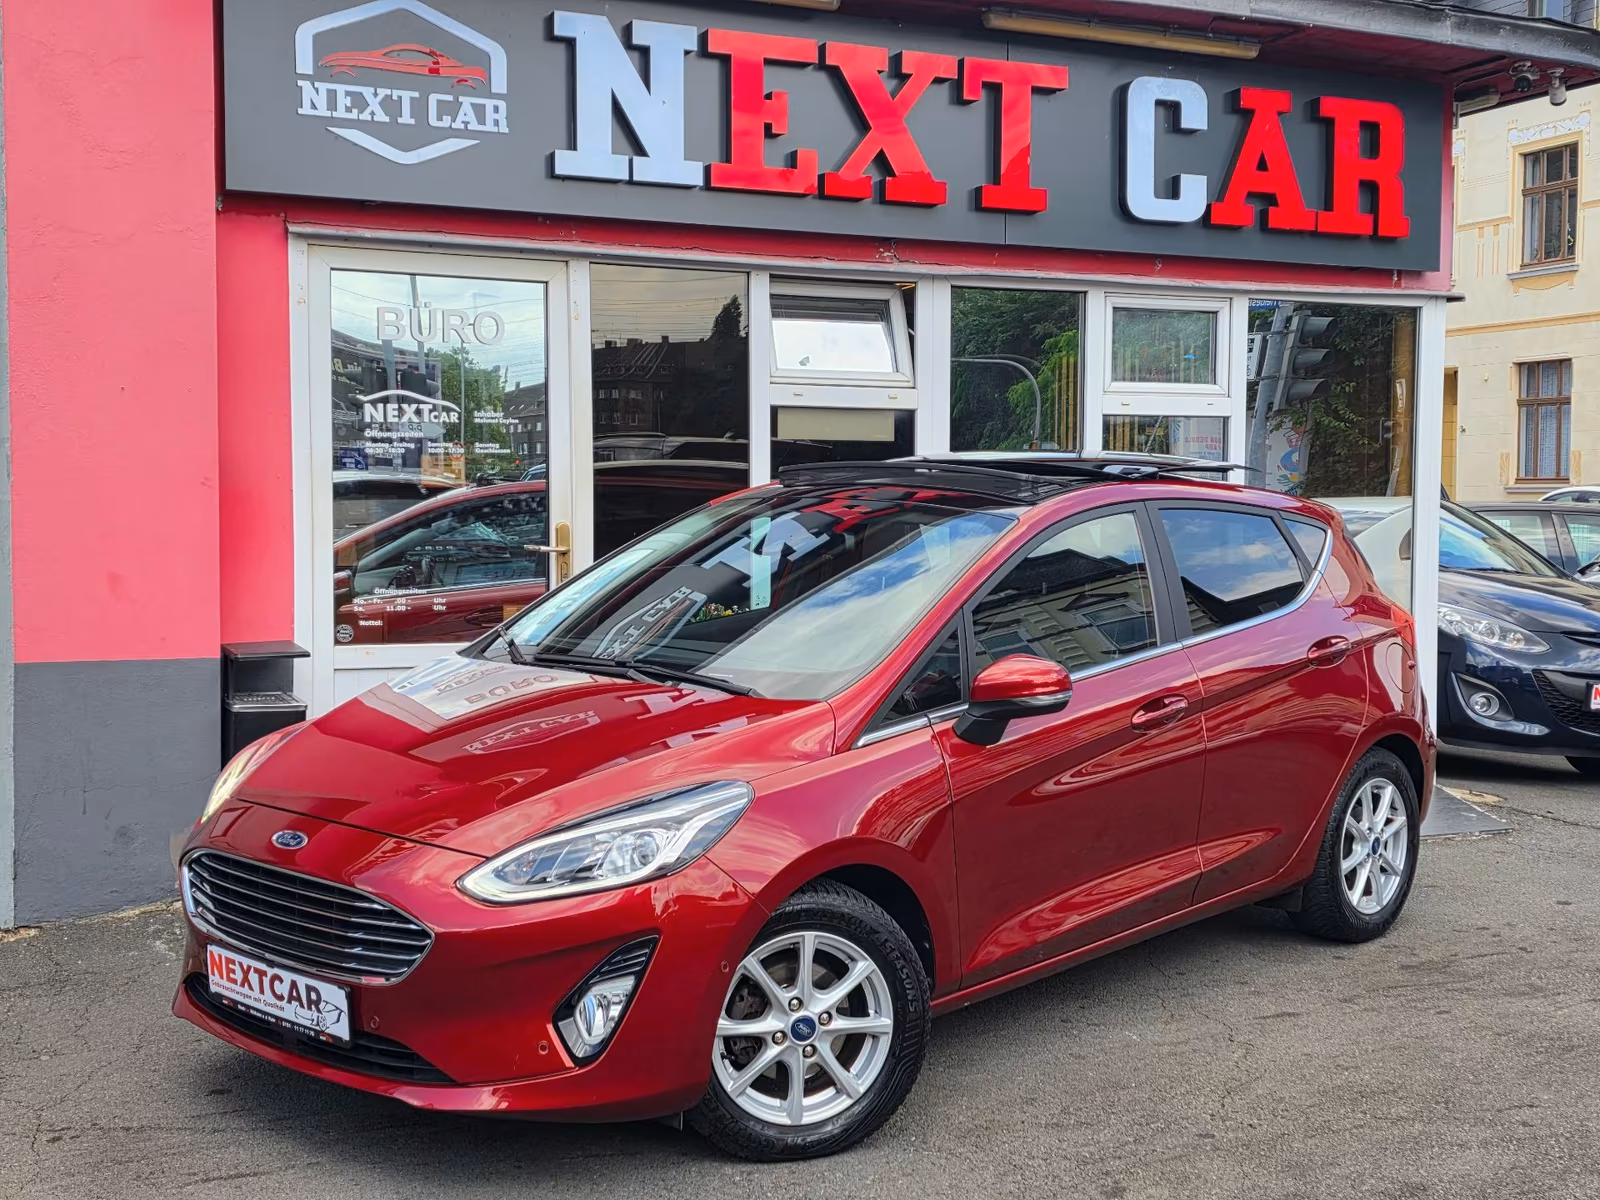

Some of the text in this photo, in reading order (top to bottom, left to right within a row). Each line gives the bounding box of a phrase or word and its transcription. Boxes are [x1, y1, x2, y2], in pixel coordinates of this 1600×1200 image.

[296, 79, 509, 134] NEXT CAR
[551, 10, 1410, 239] NEXT CAR
[376, 300, 506, 346] BÜRO
[474, 410, 505, 418] Inhaber
[363, 427, 424, 439] Öffnungszeiten
[365, 441, 390, 449] Montag
[393, 441, 415, 449] Freitag
[427, 441, 453, 449] Samstag
[475, 441, 500, 449] Sonntag
[374, 587, 428, 595] Öffnungszeiten
[209, 949, 324, 1015] NEXTCAR
[211, 979, 285, 1012] Gebrauchtwagen mit Qualität
